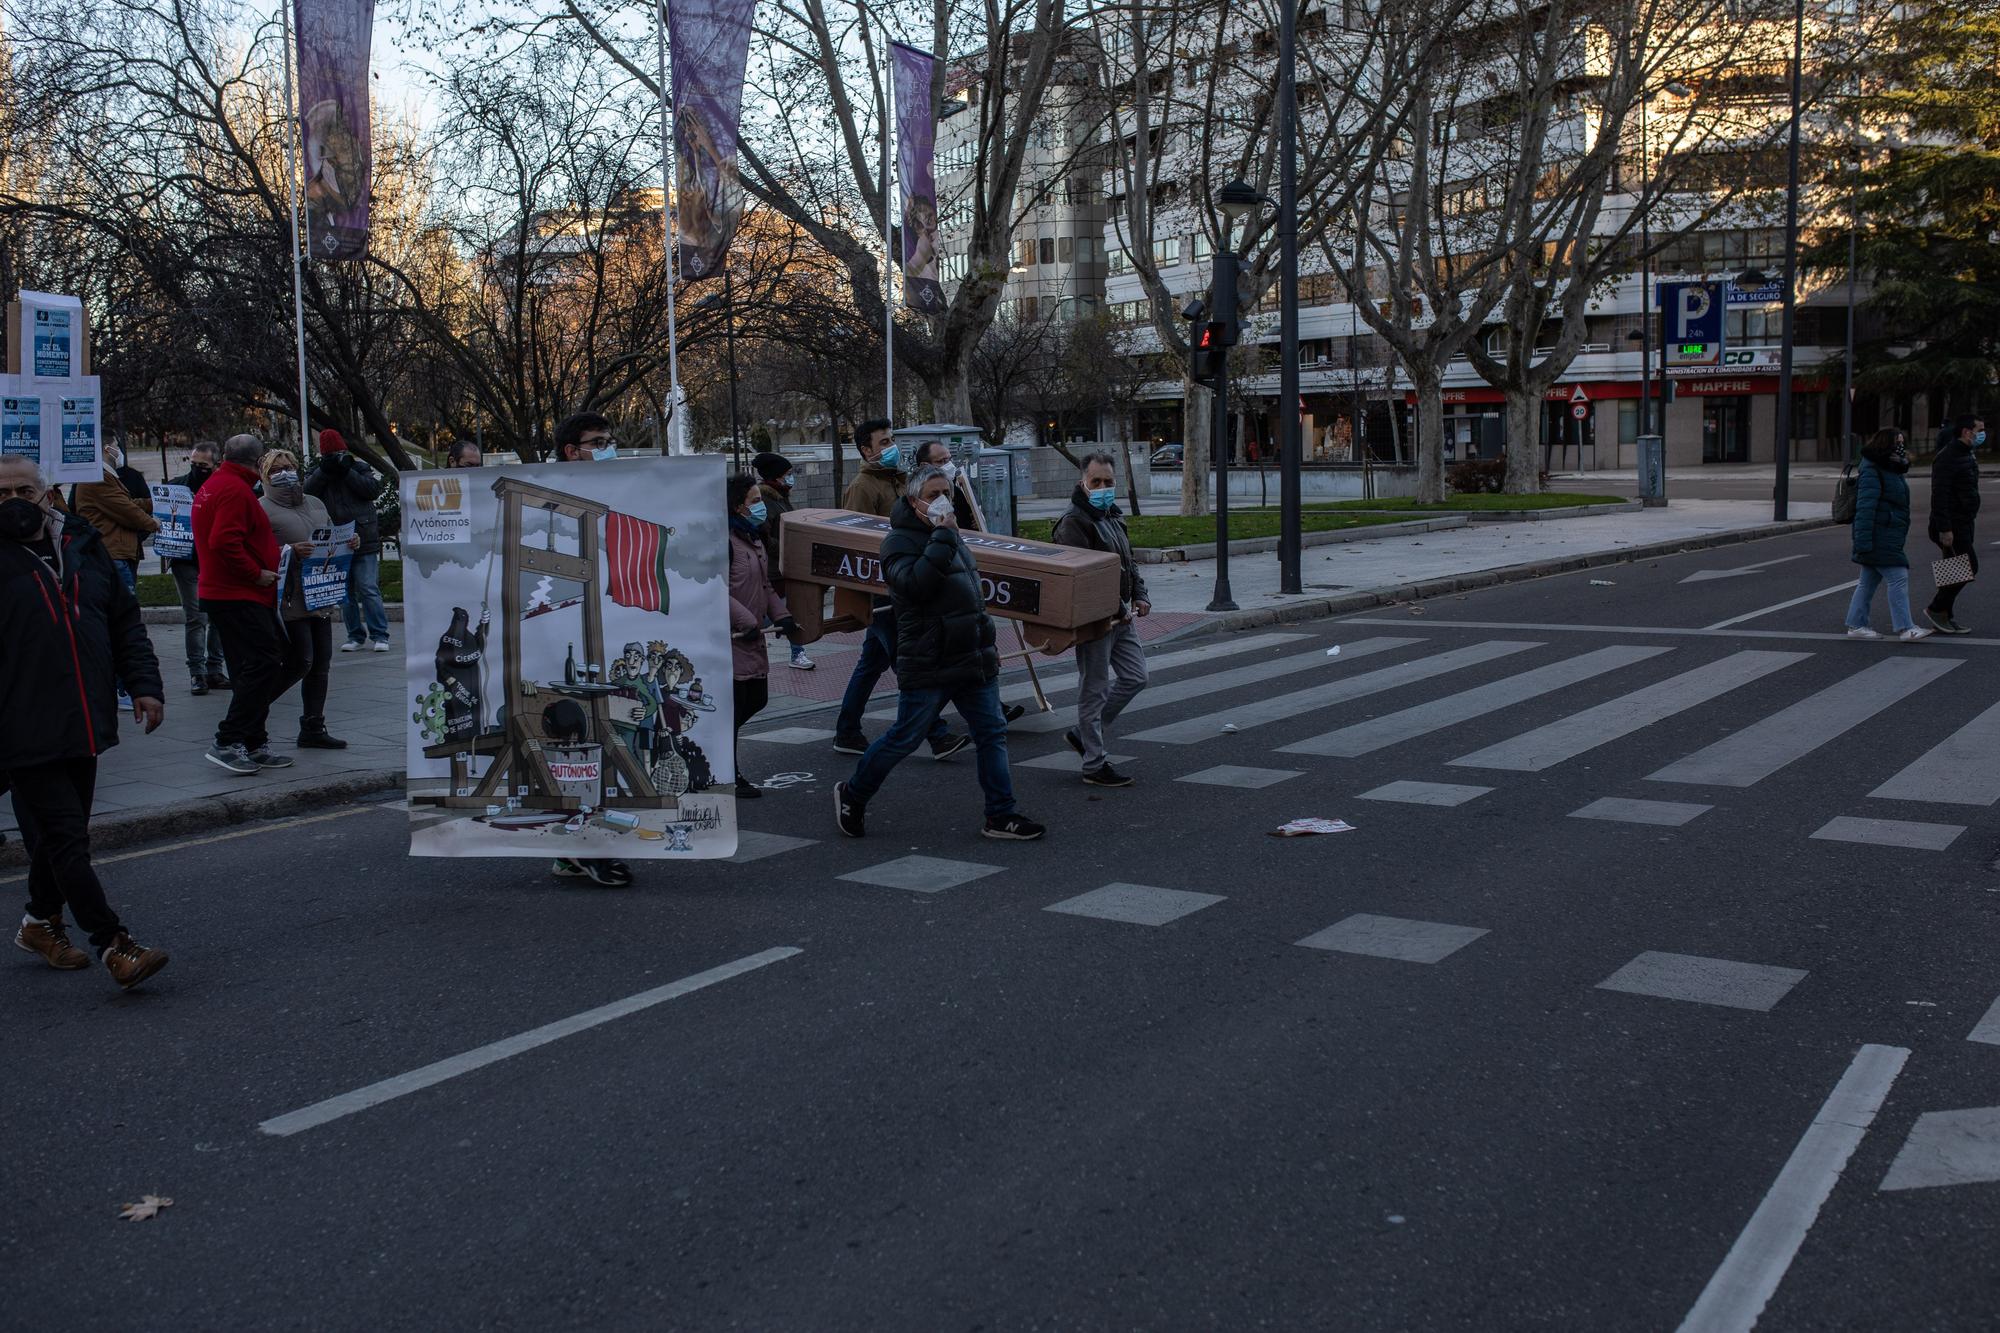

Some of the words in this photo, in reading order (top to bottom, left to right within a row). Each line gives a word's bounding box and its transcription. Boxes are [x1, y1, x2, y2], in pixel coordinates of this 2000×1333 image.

[1738, 293, 1748, 301] DE
[1749, 292, 1781, 301] SEGURO
[42, 343, 51, 351] ES
[1683, 345, 1703, 353] LIBRE
[37, 351, 69, 359] MOMENTO
[1725, 352, 1755, 364] CO
[1692, 381, 1752, 392] MAPFRE
[1545, 388, 1568, 398] PFRE
[4, 439, 39, 447] MOMENTO
[64, 438, 94, 446] MOMENTO
[161, 521, 172, 530] ES
[174, 522, 185, 531] EL
[311, 565, 324, 575] ES
[326, 564, 338, 573] EL
[303, 571, 348, 586] MOMENTO
